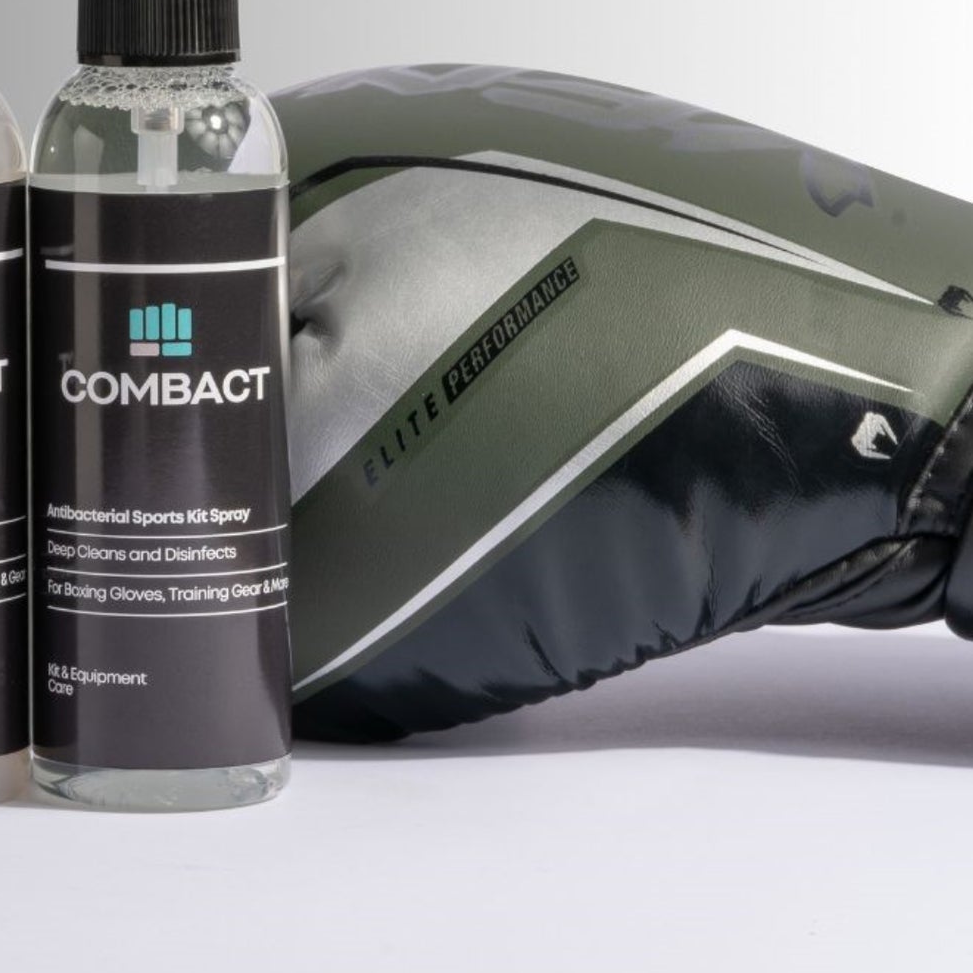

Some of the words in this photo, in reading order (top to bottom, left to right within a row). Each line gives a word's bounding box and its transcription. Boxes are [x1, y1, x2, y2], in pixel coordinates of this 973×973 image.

[363, 393, 439, 487] ELITE
[447, 258, 578, 396] PERFORMANCE
[61, 366, 270, 405] COMBACT
[47, 503, 130, 524] Antibacterial
[132, 509, 185, 526] Sports
[186, 508, 208, 523] Kit
[210, 507, 251, 525] Spray
[47, 540, 76, 559] Deep
[78, 544, 126, 561] Cleans
[129, 547, 161, 562] and
[165, 545, 237, 562] Disinfects
[0, 572, 8, 586] &
[47, 579, 63, 595] For
[64, 581, 107, 602] Boxing
[109, 586, 166, 603] Gloves,
[168, 585, 229, 602] Training
[231, 582, 263, 598] Gear
[263, 579, 270, 594] &
[48, 662, 60, 678] Kit
[61, 665, 69, 679] &
[70, 667, 147, 686] Equipment
[48, 678, 74, 696] Care
